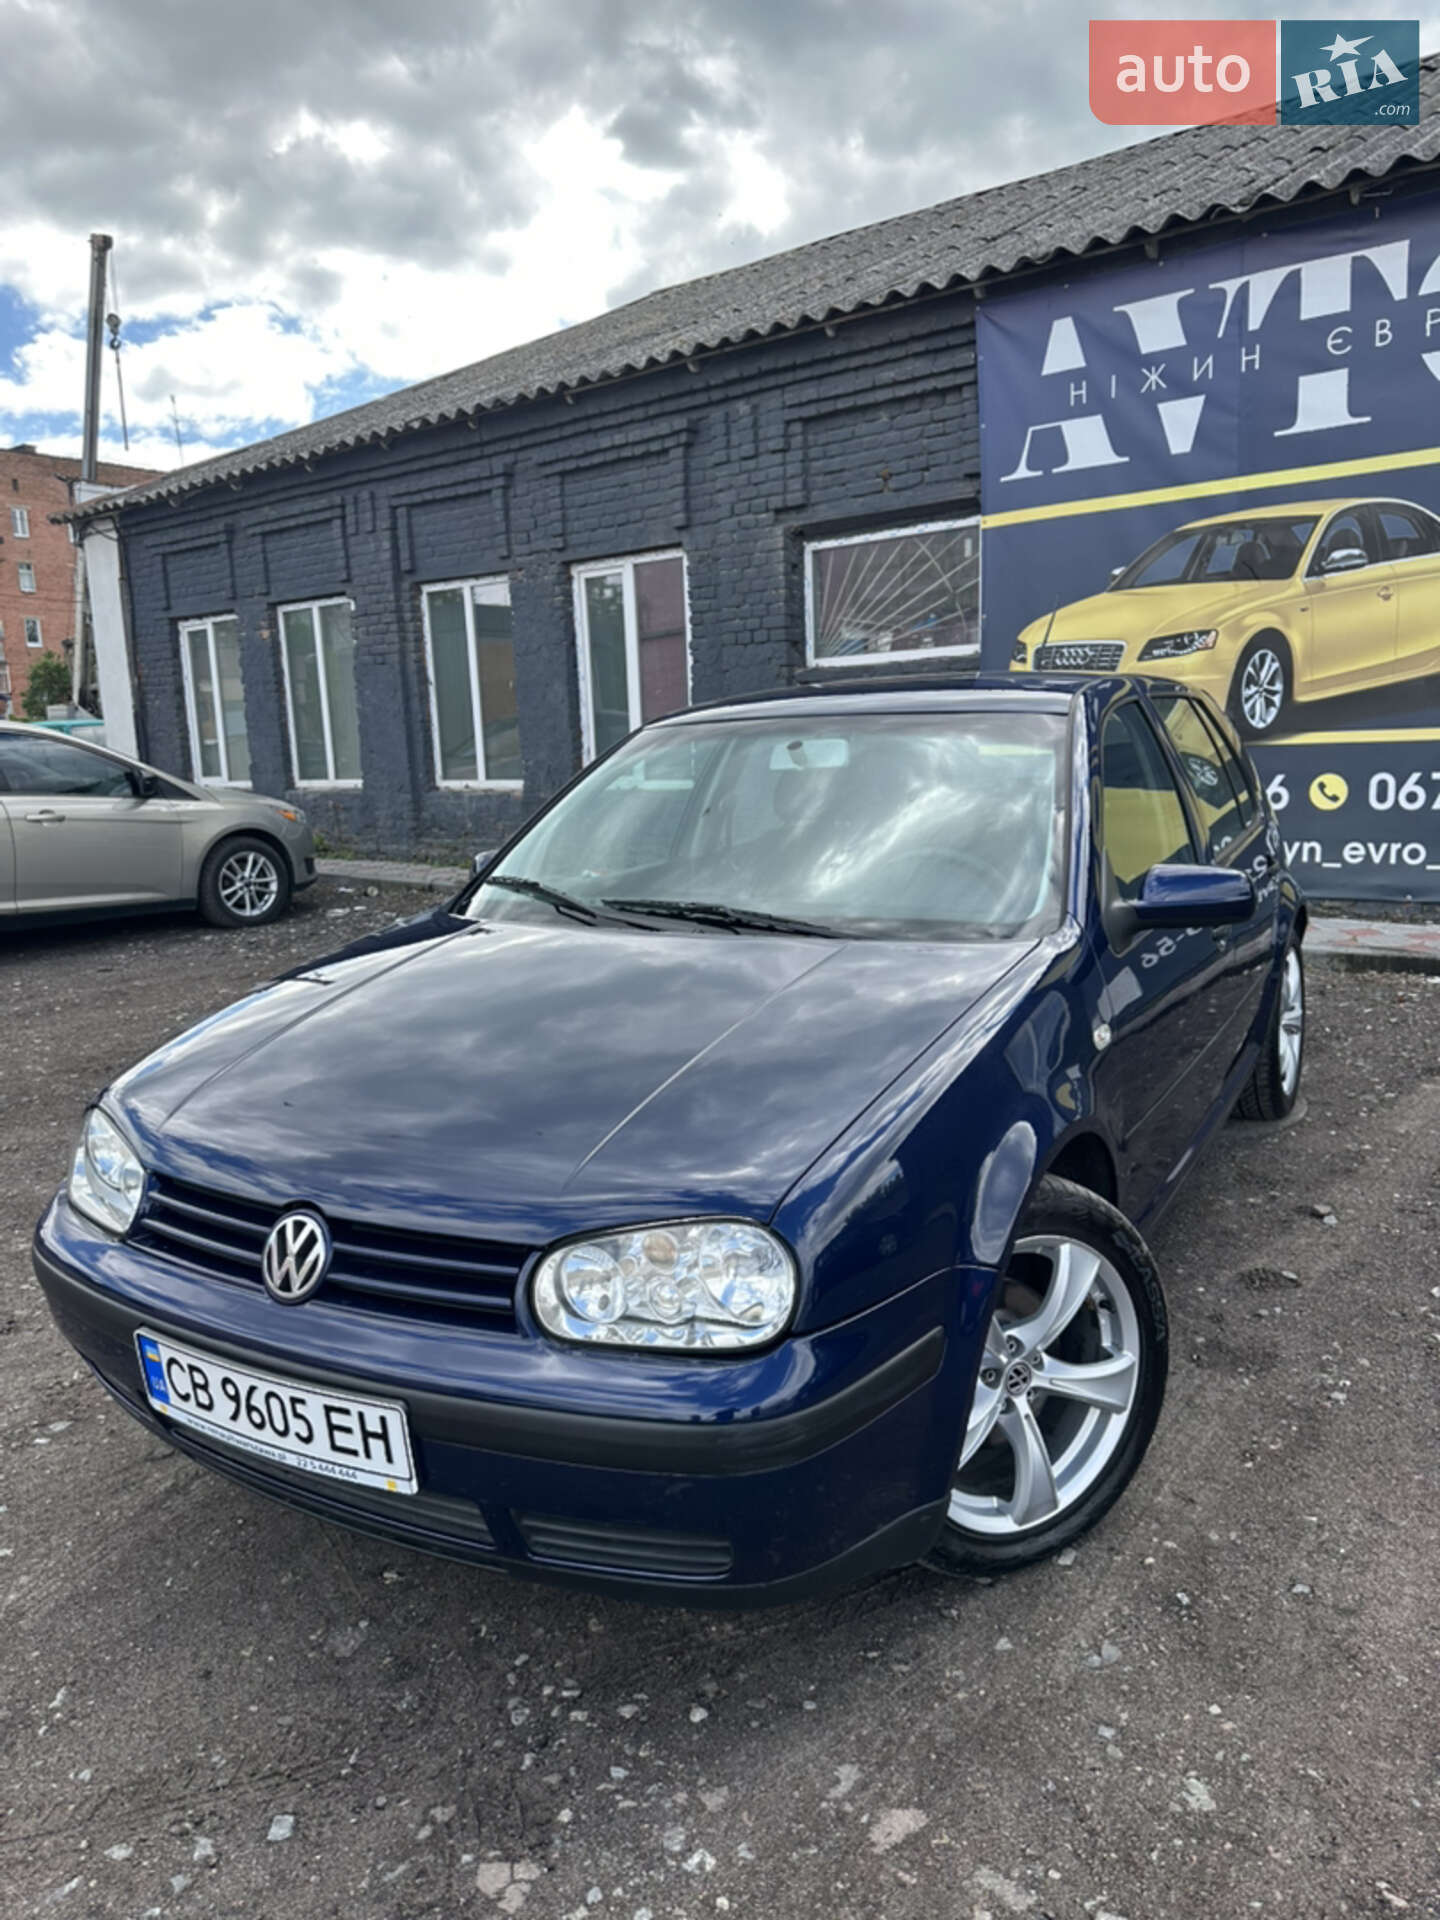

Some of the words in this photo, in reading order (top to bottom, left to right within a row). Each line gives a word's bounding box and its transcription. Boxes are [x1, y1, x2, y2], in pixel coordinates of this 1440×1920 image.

[1000, 240, 1440, 482] AVT
[1069, 344, 1261, 407] НІЖИН
[166, 1357, 214, 1412] CB
[221, 1377, 314, 1445] 9605
[323, 1404, 393, 1464] EH
